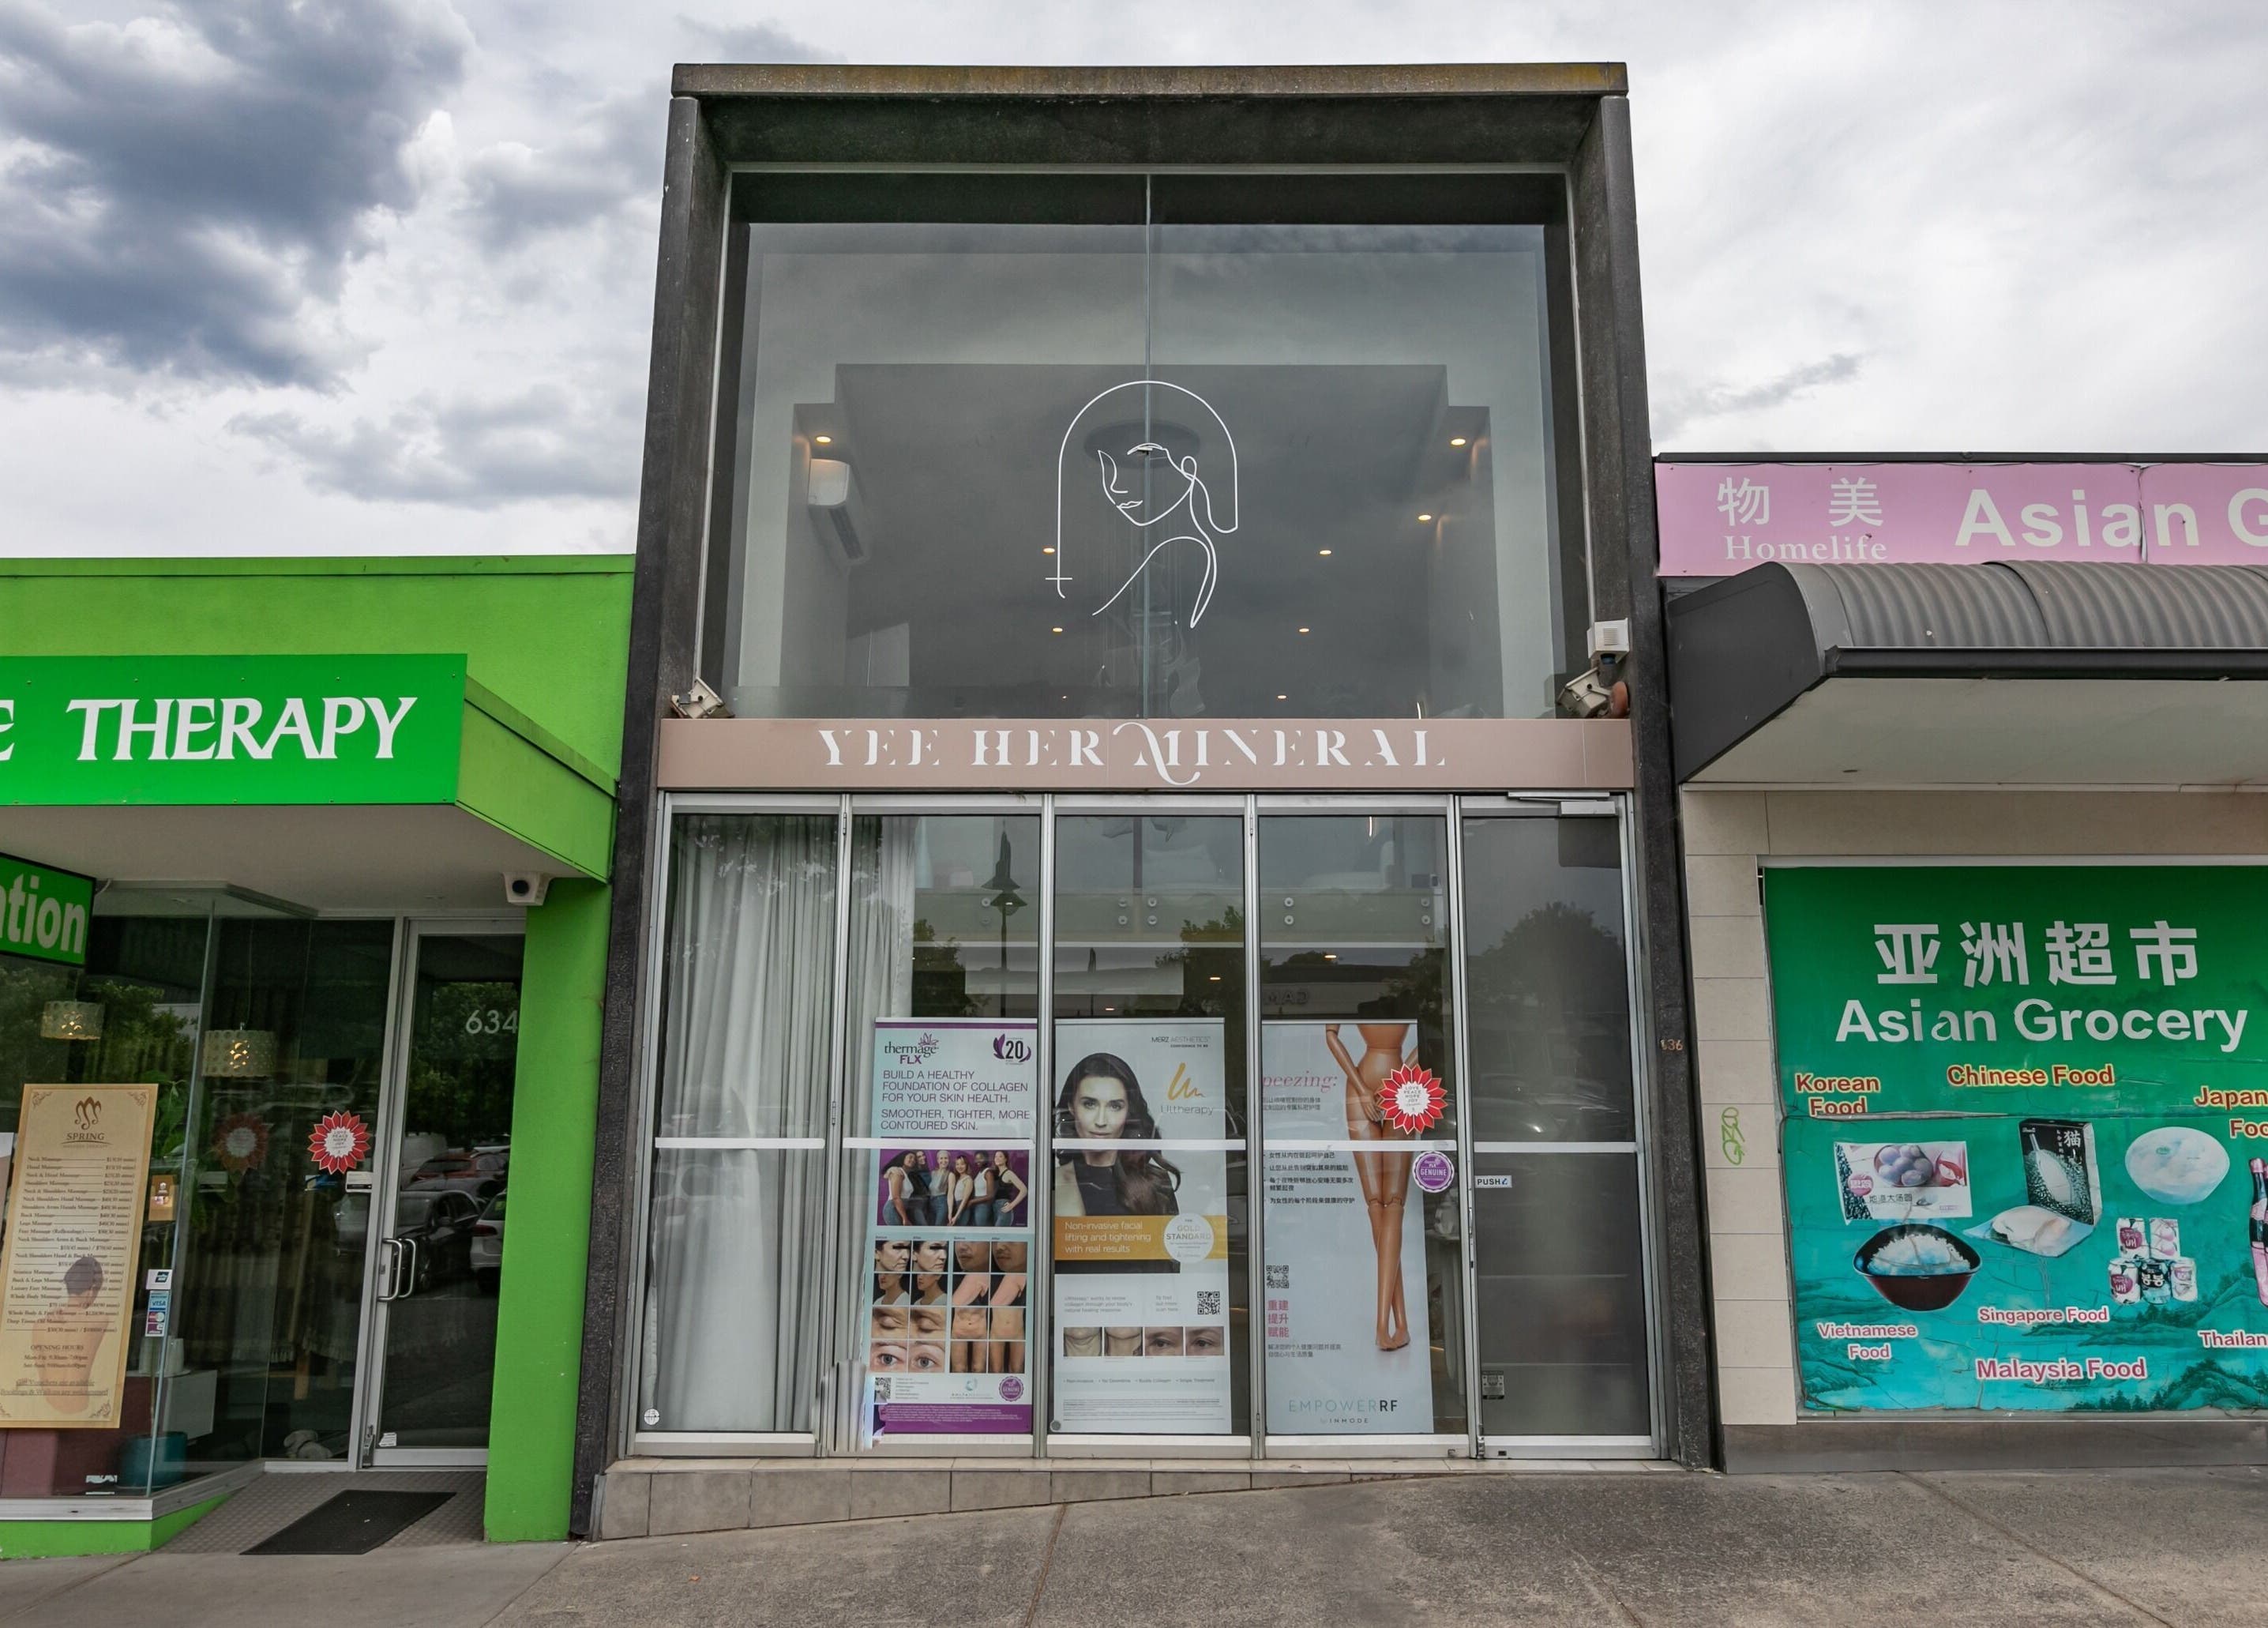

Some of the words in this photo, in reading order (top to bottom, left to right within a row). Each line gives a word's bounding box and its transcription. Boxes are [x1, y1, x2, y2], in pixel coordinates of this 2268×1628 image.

[1716, 478, 1770, 526] 物
[1829, 478, 1884, 527] 美
[1955, 489, 2199, 547] Asian
[1725, 535, 1887, 560] Homelife
[66, 697, 418, 761] THERAPY
[818, 730, 940, 765] YEE
[971, 730, 1105, 765] HER
[1113, 722, 1446, 785] MINERAL
[1874, 920, 2199, 987] 亚洲超市
[465, 1010, 518, 1034] 634
[1835, 998, 1997, 1042] Asian
[2014, 998, 2247, 1051] Grocery
[884, 1041, 937, 1057] thermage
[1005, 1040, 1023, 1059] 20
[899, 1055, 922, 1064] FLX
[883, 1070, 914, 1079] BUILD
[918, 1070, 924, 1079] A
[928, 1070, 974, 1079] HEALTHY
[1947, 1066, 2048, 1087] Chinese
[2052, 1065, 2114, 1085] Food
[883, 1082, 950, 1092] FOUNDATION
[953, 1082, 967, 1092] OF
[971, 1082, 1028, 1092] COLLAGEN
[1795, 1073, 1880, 1093] Korean
[882, 1093, 903, 1103] FOR
[907, 1093, 937, 1103] YOUR
[940, 1093, 964, 1103] SKIN
[967, 1093, 1011, 1103] HEALTH.
[1809, 1096, 1867, 1115] Food
[2194, 1086, 2268, 1110] Japan
[881, 1109, 944, 1120] SMOOTHER,
[948, 1109, 995, 1120] TIGHTER,
[998, 1109, 1030, 1120] MORE
[881, 1121, 948, 1130] CONTOURED
[952, 1121, 978, 1130] SKIN.
[1065, 1222, 1119, 1231] Non-invasive
[1121, 1222, 1143, 1231] facial
[1065, 1233, 1087, 1243] lifting
[1091, 1233, 1106, 1243] and
[1109, 1233, 1151, 1243] tightening
[1267, 1300, 1289, 1310] 重建
[1267, 1313, 1289, 1325] 提升
[1978, 1307, 2063, 1324] Singapore
[2067, 1307, 2110, 1324] Food
[1267, 1327, 1290, 1338] 赋能
[1818, 1322, 1918, 1338] Vietnamese
[1849, 1344, 1891, 1359] Food
[1977, 1359, 2081, 1383] Malaysia
[2086, 1358, 2147, 1379] Food
[1289, 1400, 1399, 1412] EMPOWERRF
